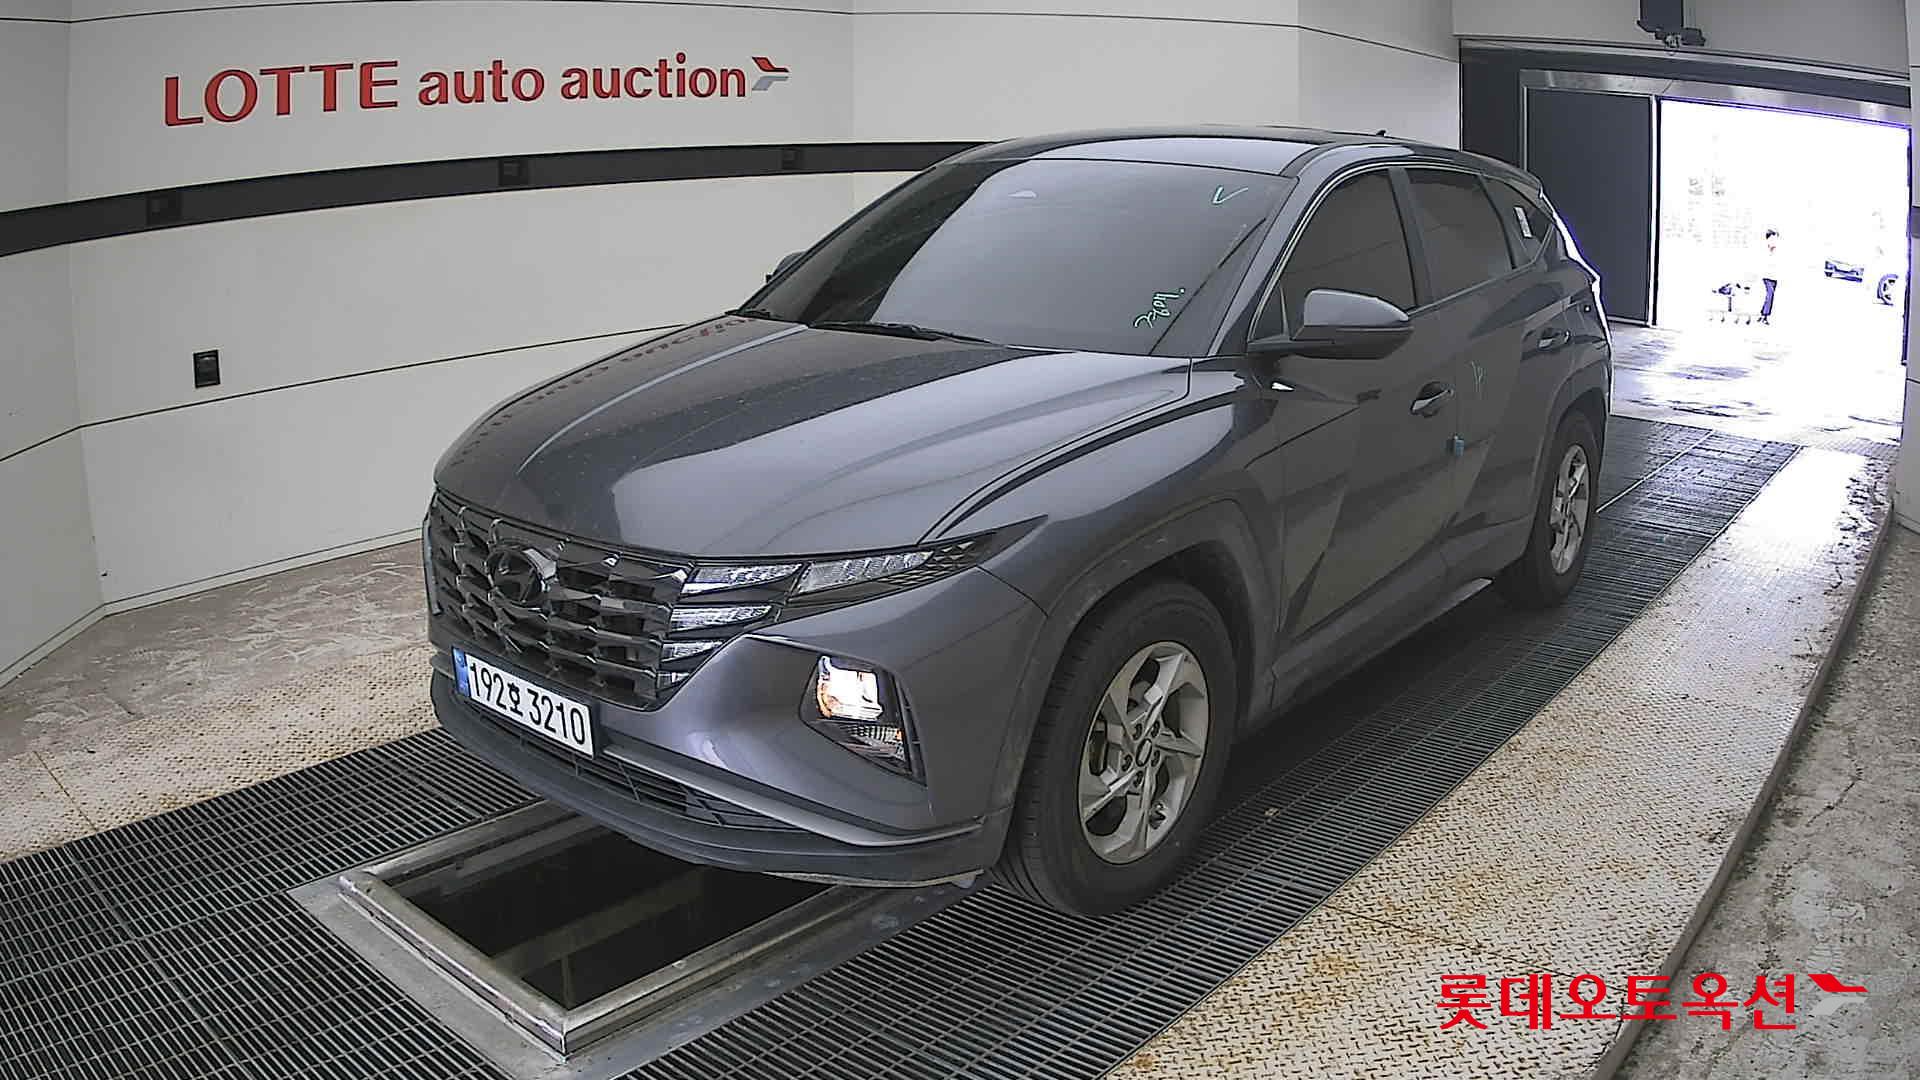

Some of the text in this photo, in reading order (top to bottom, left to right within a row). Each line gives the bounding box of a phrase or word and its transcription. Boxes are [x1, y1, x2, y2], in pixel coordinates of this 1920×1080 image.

[164, 52, 747, 127] LOTTE auto auction
[527, 688, 586, 745] 3210
